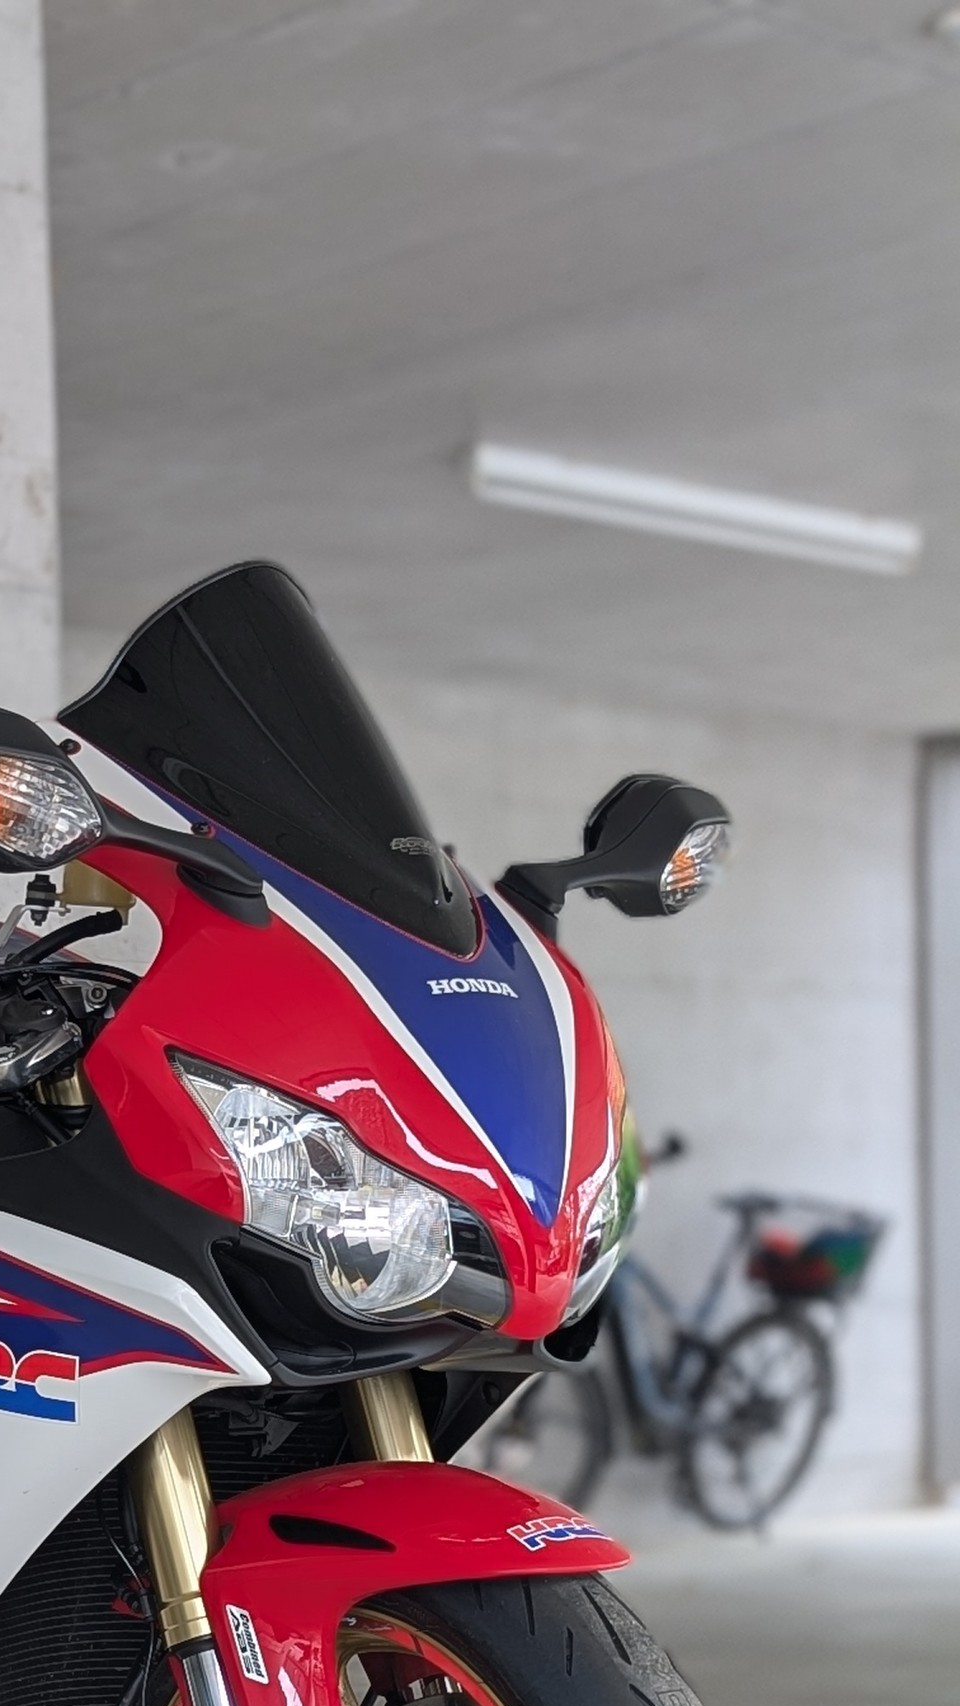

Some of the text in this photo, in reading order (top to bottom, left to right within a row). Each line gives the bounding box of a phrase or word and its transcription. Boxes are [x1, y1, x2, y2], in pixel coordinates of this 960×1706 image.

[426, 977, 519, 999] HONDA
[229, 1608, 254, 1674] ABS
[240, 1613, 265, 1678] Combined
